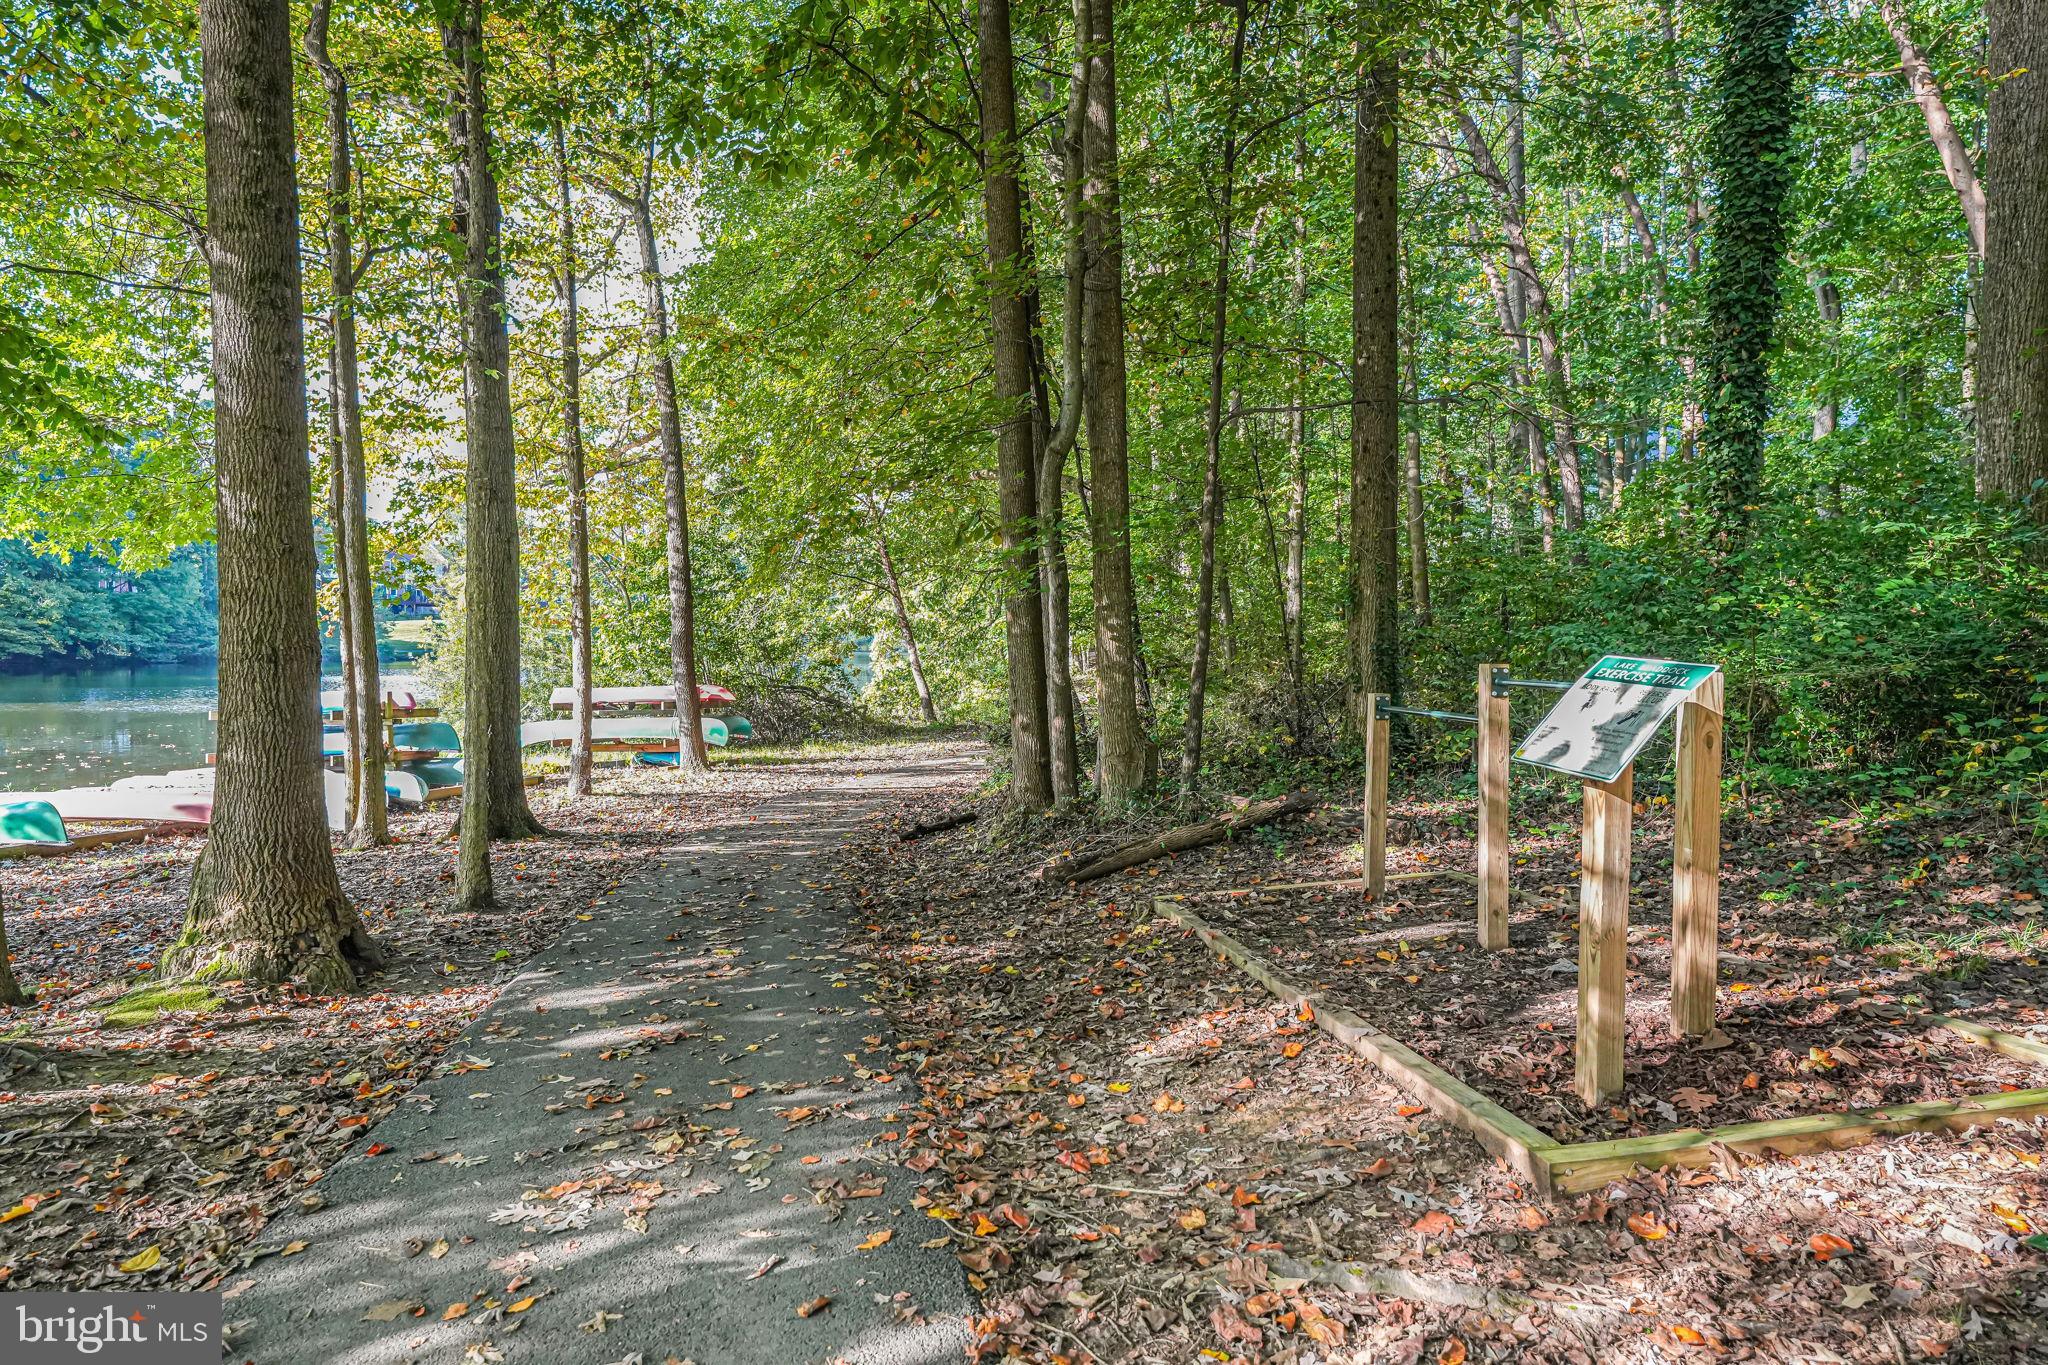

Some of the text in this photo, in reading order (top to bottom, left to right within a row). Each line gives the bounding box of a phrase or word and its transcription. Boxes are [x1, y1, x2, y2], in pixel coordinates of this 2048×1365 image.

[1614, 662, 1691, 675] LAKE DDOCK
[1594, 668, 1690, 687] EXERCISE TRAIL
